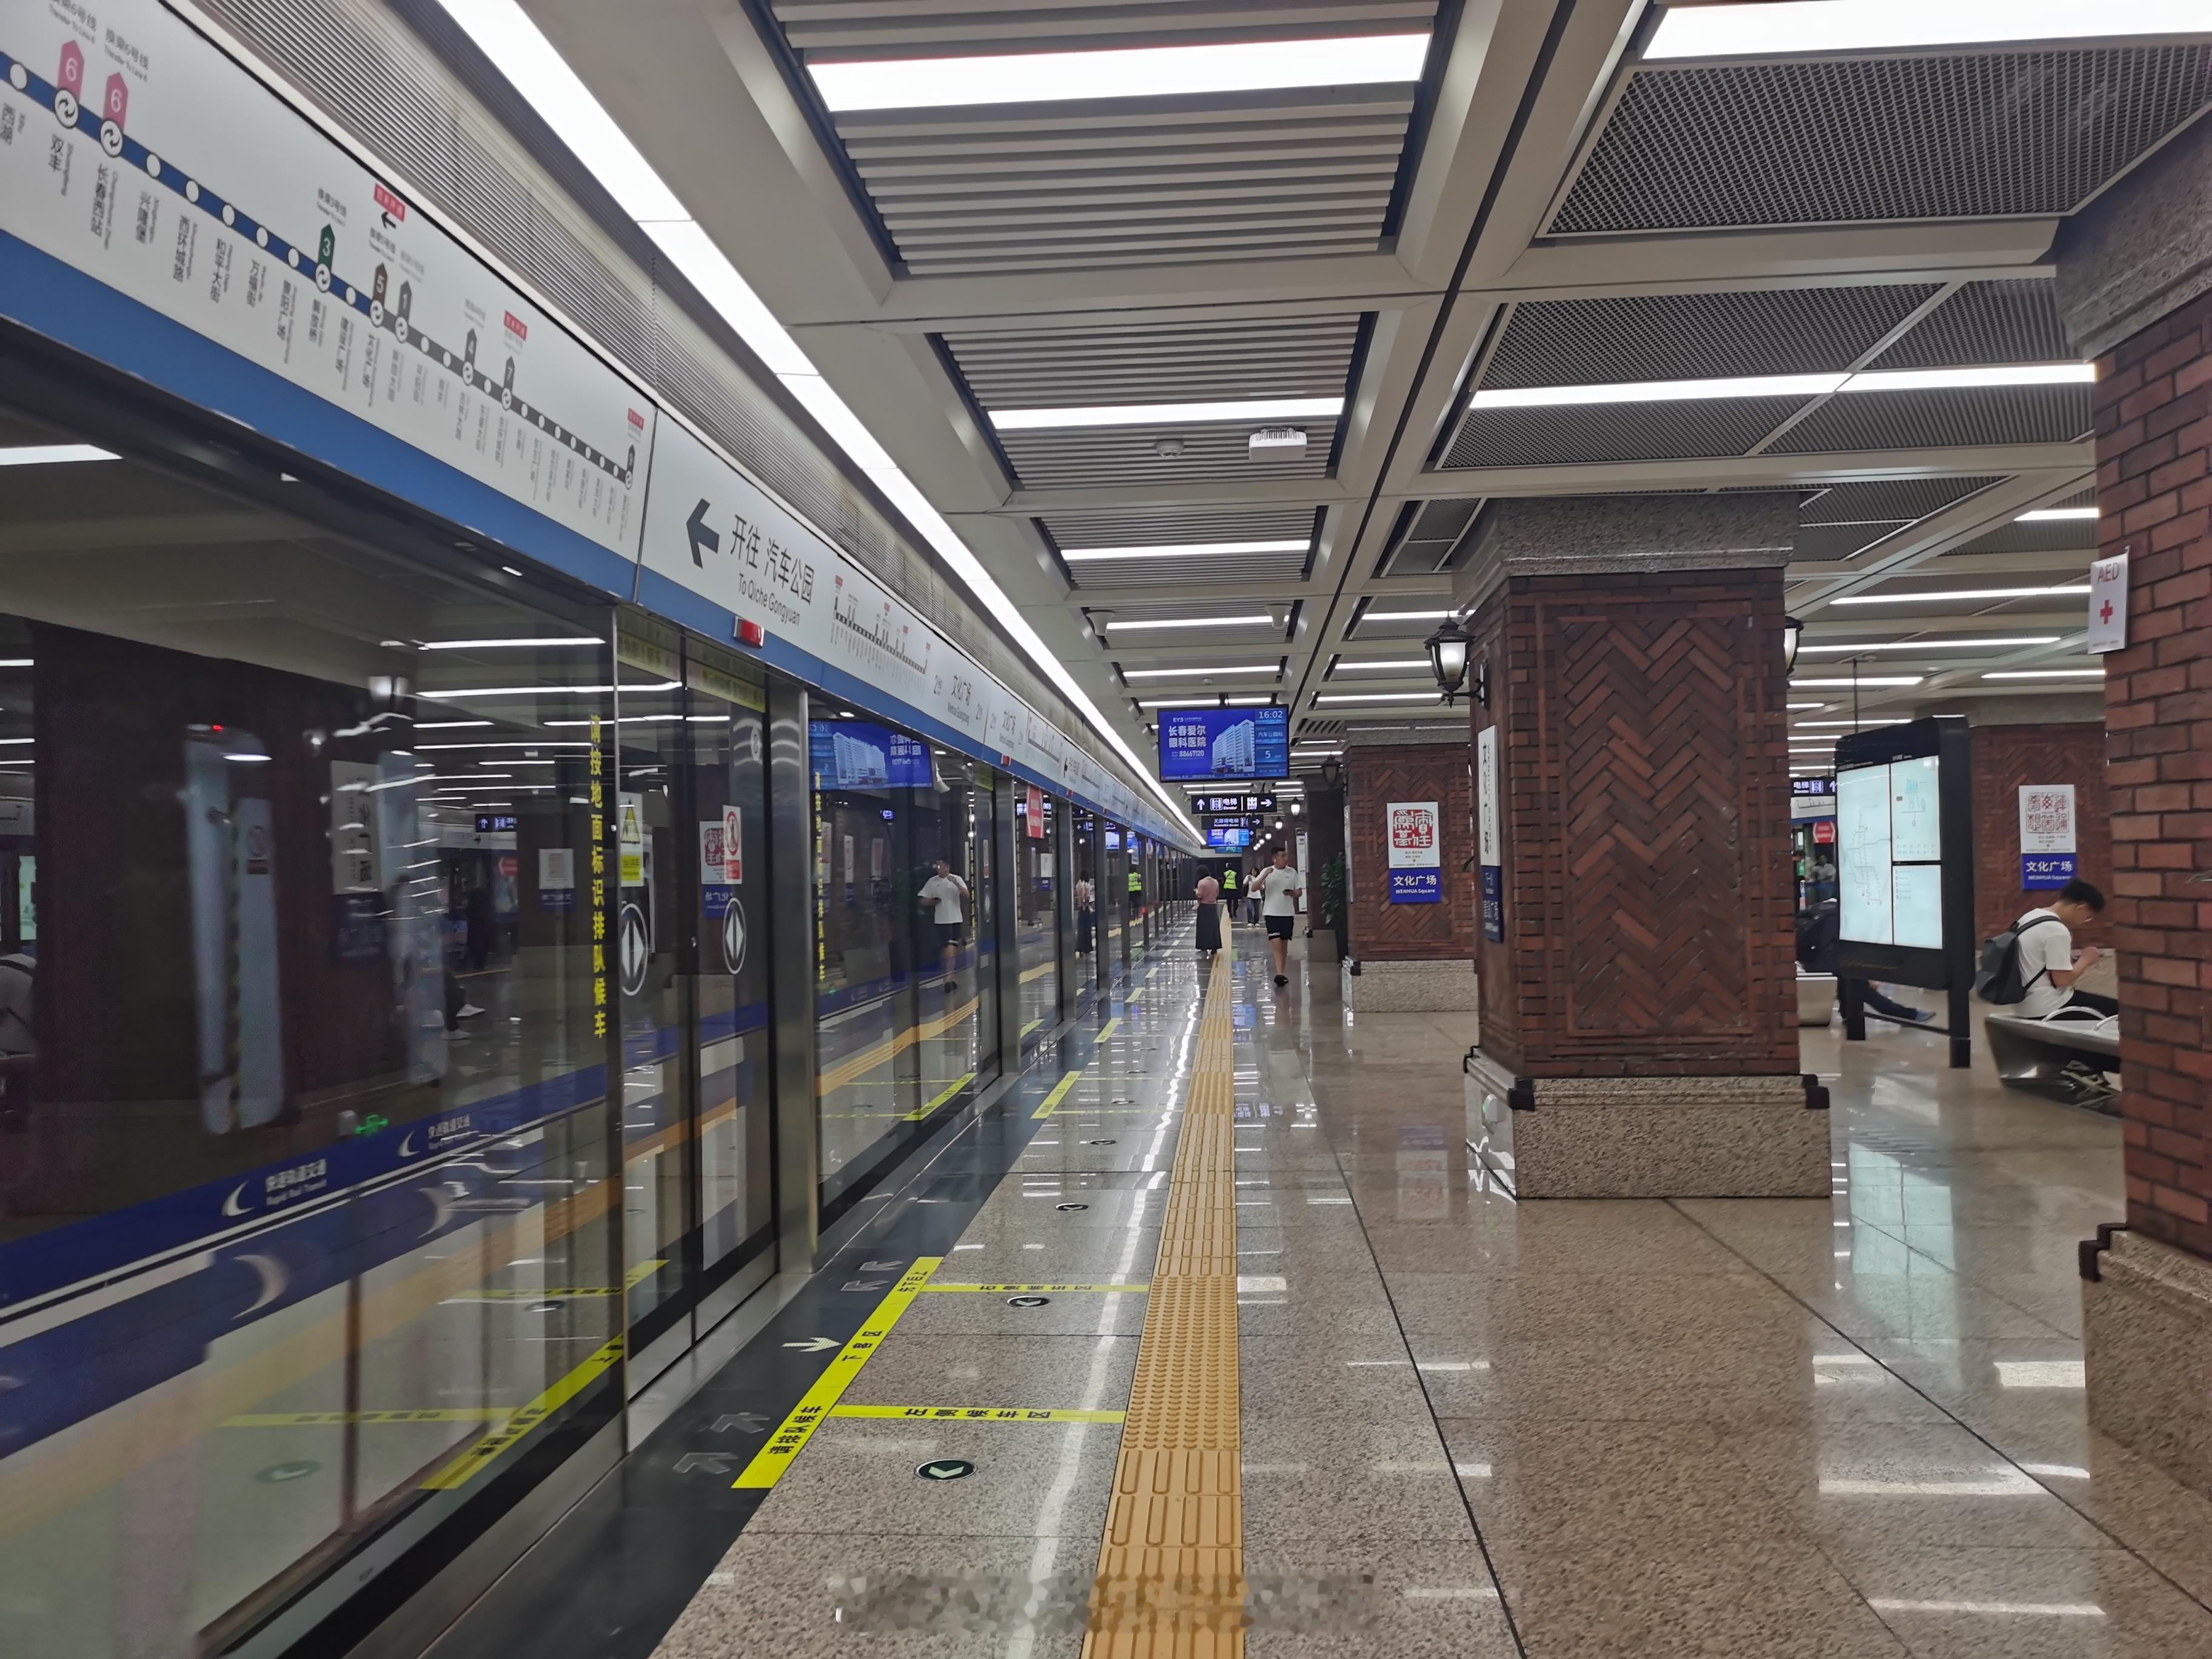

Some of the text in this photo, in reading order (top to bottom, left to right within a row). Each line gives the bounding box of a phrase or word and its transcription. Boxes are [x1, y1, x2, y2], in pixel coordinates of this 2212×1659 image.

[65, 57, 78, 82] 6
[110, 89, 122, 113] 6
[322, 236, 332, 257] 3
[375, 274, 385, 293] 5
[731, 514, 815, 606] 开往 汽车公园
[2097, 562, 2120, 585] AED
[739, 573, 800, 626] To Qiche Gongyuan
[1168, 725, 1206, 736] 长春爱尔
[1168, 737, 1207, 748] 眼科医院
[589, 714, 608, 1040] 请按地面标识排队候车
[2025, 861, 2073, 873] 文化广场
[1393, 874, 1437, 887] 文化广场
[897, 1271, 928, 1293] 先下后上
[841, 1330, 883, 1362] 下客区
[903, 1408, 1053, 1419] 左侧候车区
[766, 1405, 823, 1455] 请排队候车
